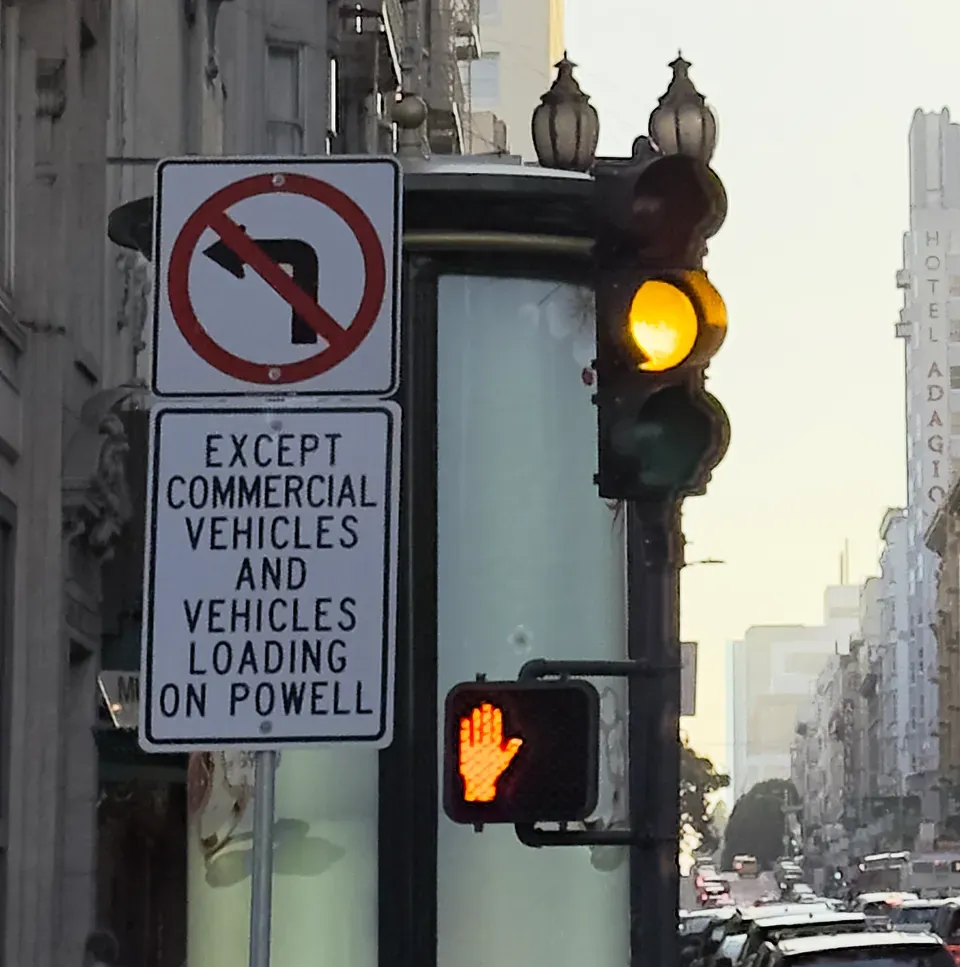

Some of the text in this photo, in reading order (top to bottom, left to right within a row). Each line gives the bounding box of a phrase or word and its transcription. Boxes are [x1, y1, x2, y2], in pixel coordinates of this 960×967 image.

[925, 230, 945, 503] HOTEL ADAGIO
[205, 433, 342, 468] EXCEPT
[166, 474, 378, 509] COMMERCIAL
[185, 515, 359, 550] VEHICLES
[235, 556, 307, 591] AND
[183, 597, 357, 634] VEHICLES
[189, 639, 348, 675] LOADING
[159, 680, 373, 717] ON POWELL
